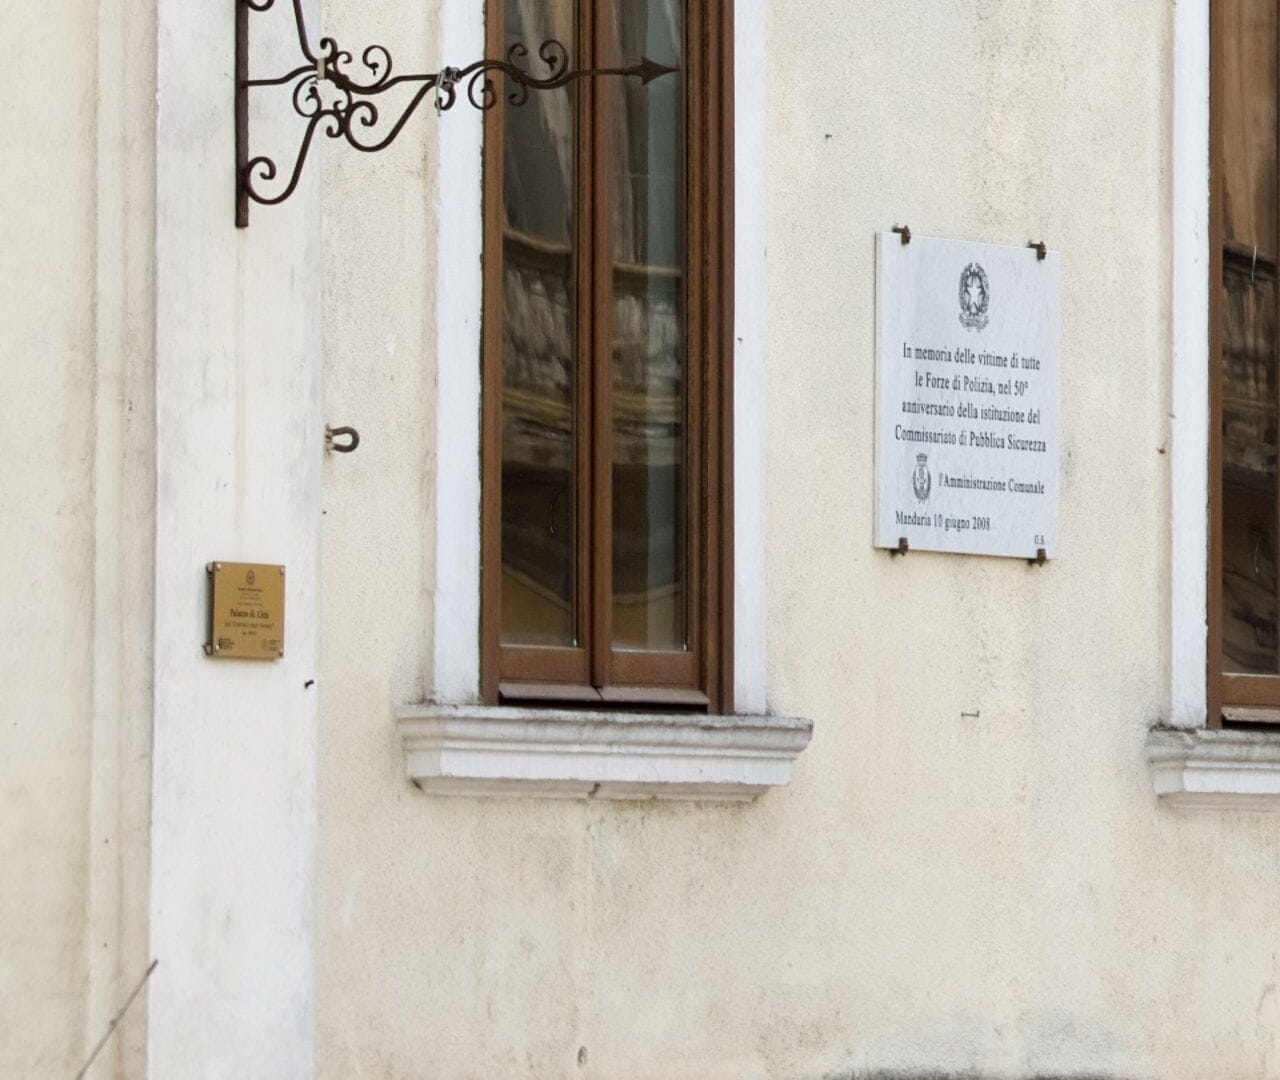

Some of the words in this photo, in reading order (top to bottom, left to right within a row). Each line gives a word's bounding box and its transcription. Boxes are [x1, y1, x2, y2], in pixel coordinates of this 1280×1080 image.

[903, 343, 912, 358] In
[915, 346, 951, 363] memoria
[954, 348, 975, 364] delle
[978, 351, 1007, 368] vittime
[1011, 353, 1019, 368] di
[1021, 354, 1041, 370] tutte
[915, 371, 922, 387] le
[926, 372, 949, 389] Forze
[952, 375, 960, 390] di
[964, 376, 995, 396] Polizia,
[998, 380, 1011, 395] nel
[902, 400, 954, 417] anniversario
[957, 403, 978, 419] della
[981, 406, 1024, 423] istituzione
[1027, 409, 1041, 424] del
[895, 425, 956, 444] Commissariato
[958, 430, 967, 446] di
[970, 431, 1005, 449] Pubblica
[1007, 435, 1047, 452] Sicurezza
[939, 473, 1006, 491] l'Amministrazione
[1008, 478, 1045, 494] Comunale
[895, 511, 931, 526] Manduria
[934, 514, 942, 527] 10
[944, 514, 970, 532] giugno
[972, 517, 990, 531] 2008
